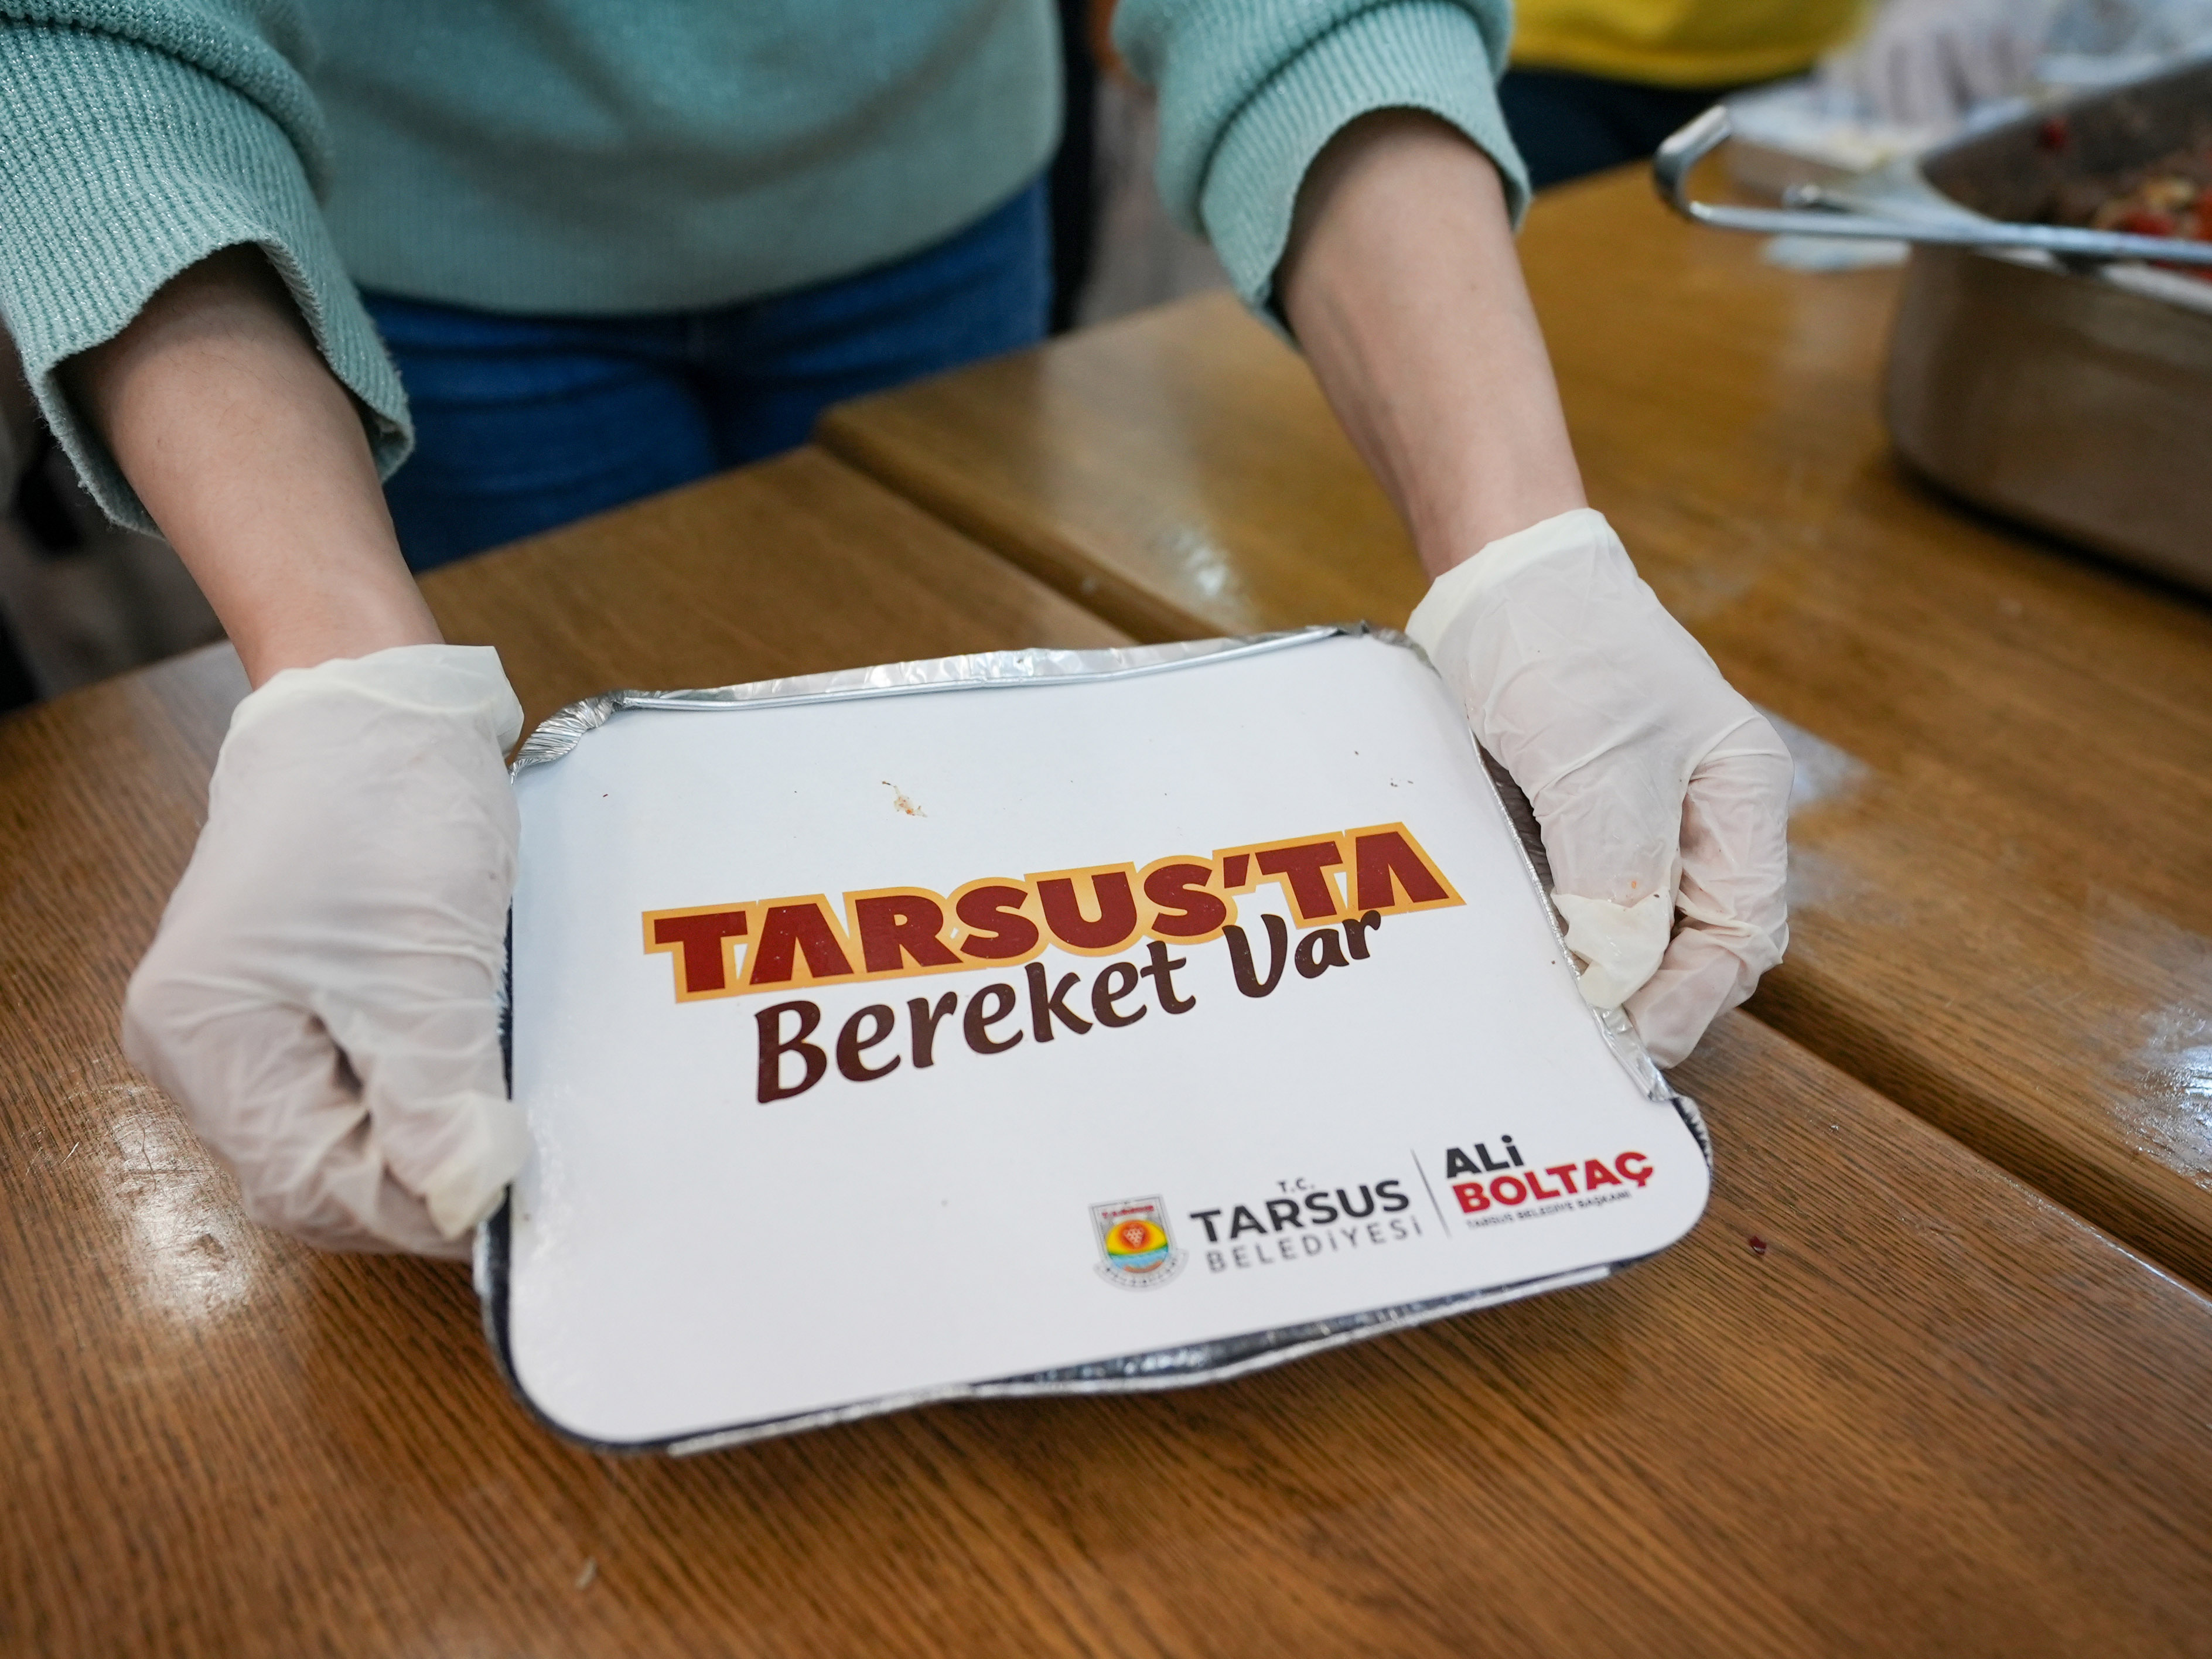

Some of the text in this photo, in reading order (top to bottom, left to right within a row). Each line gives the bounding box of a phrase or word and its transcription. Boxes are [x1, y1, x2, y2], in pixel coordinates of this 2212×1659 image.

[652, 830, 1452, 994] TARSUS'TA
[753, 909, 1382, 1104] Bereket Var
[1189, 1179, 1411, 1243] TARSUS
[1278, 1177, 1315, 1193] T.C.
[1452, 1151, 1654, 1214] BOLTAÇ
